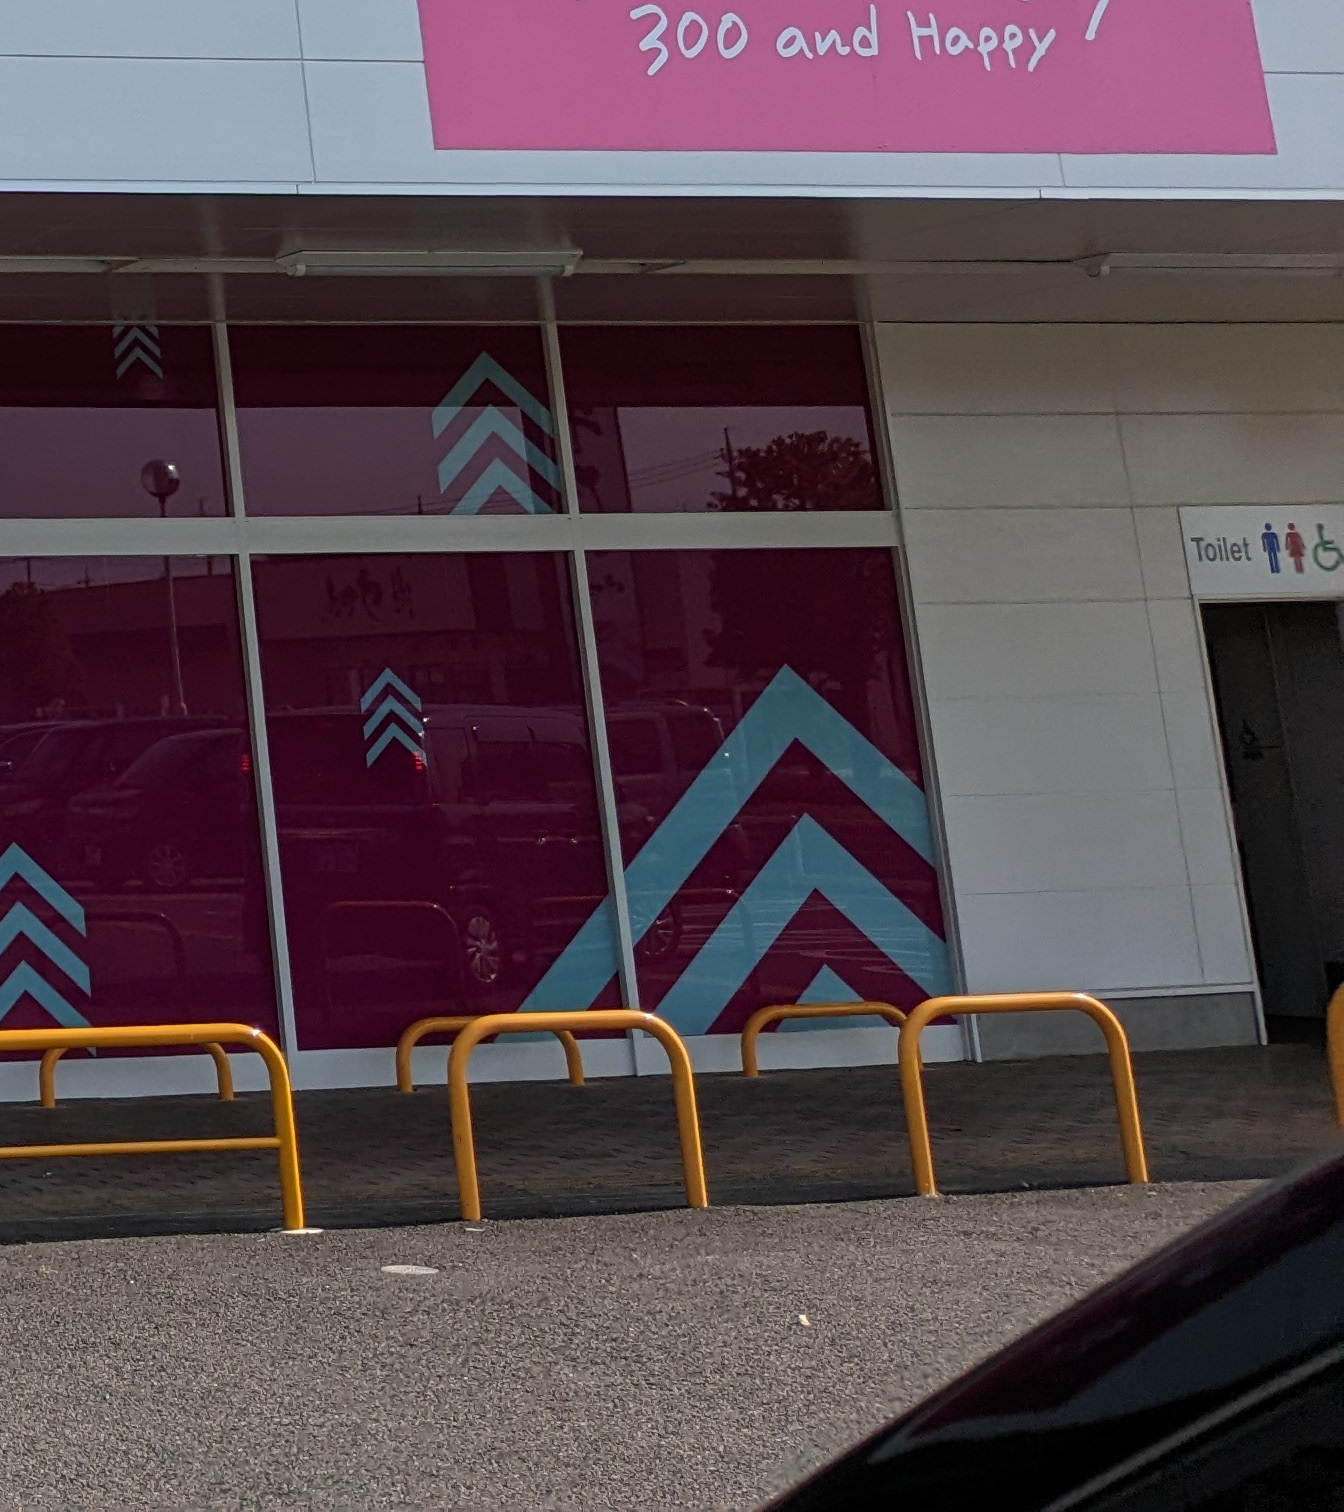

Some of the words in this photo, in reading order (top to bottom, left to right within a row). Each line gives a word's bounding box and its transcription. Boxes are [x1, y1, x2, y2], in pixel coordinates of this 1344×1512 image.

[630, 3, 748, 76] 300
[776, 3, 879, 60] and
[906, 10, 1057, 73] Happy
[1190, 536, 1253, 563] Toilet
